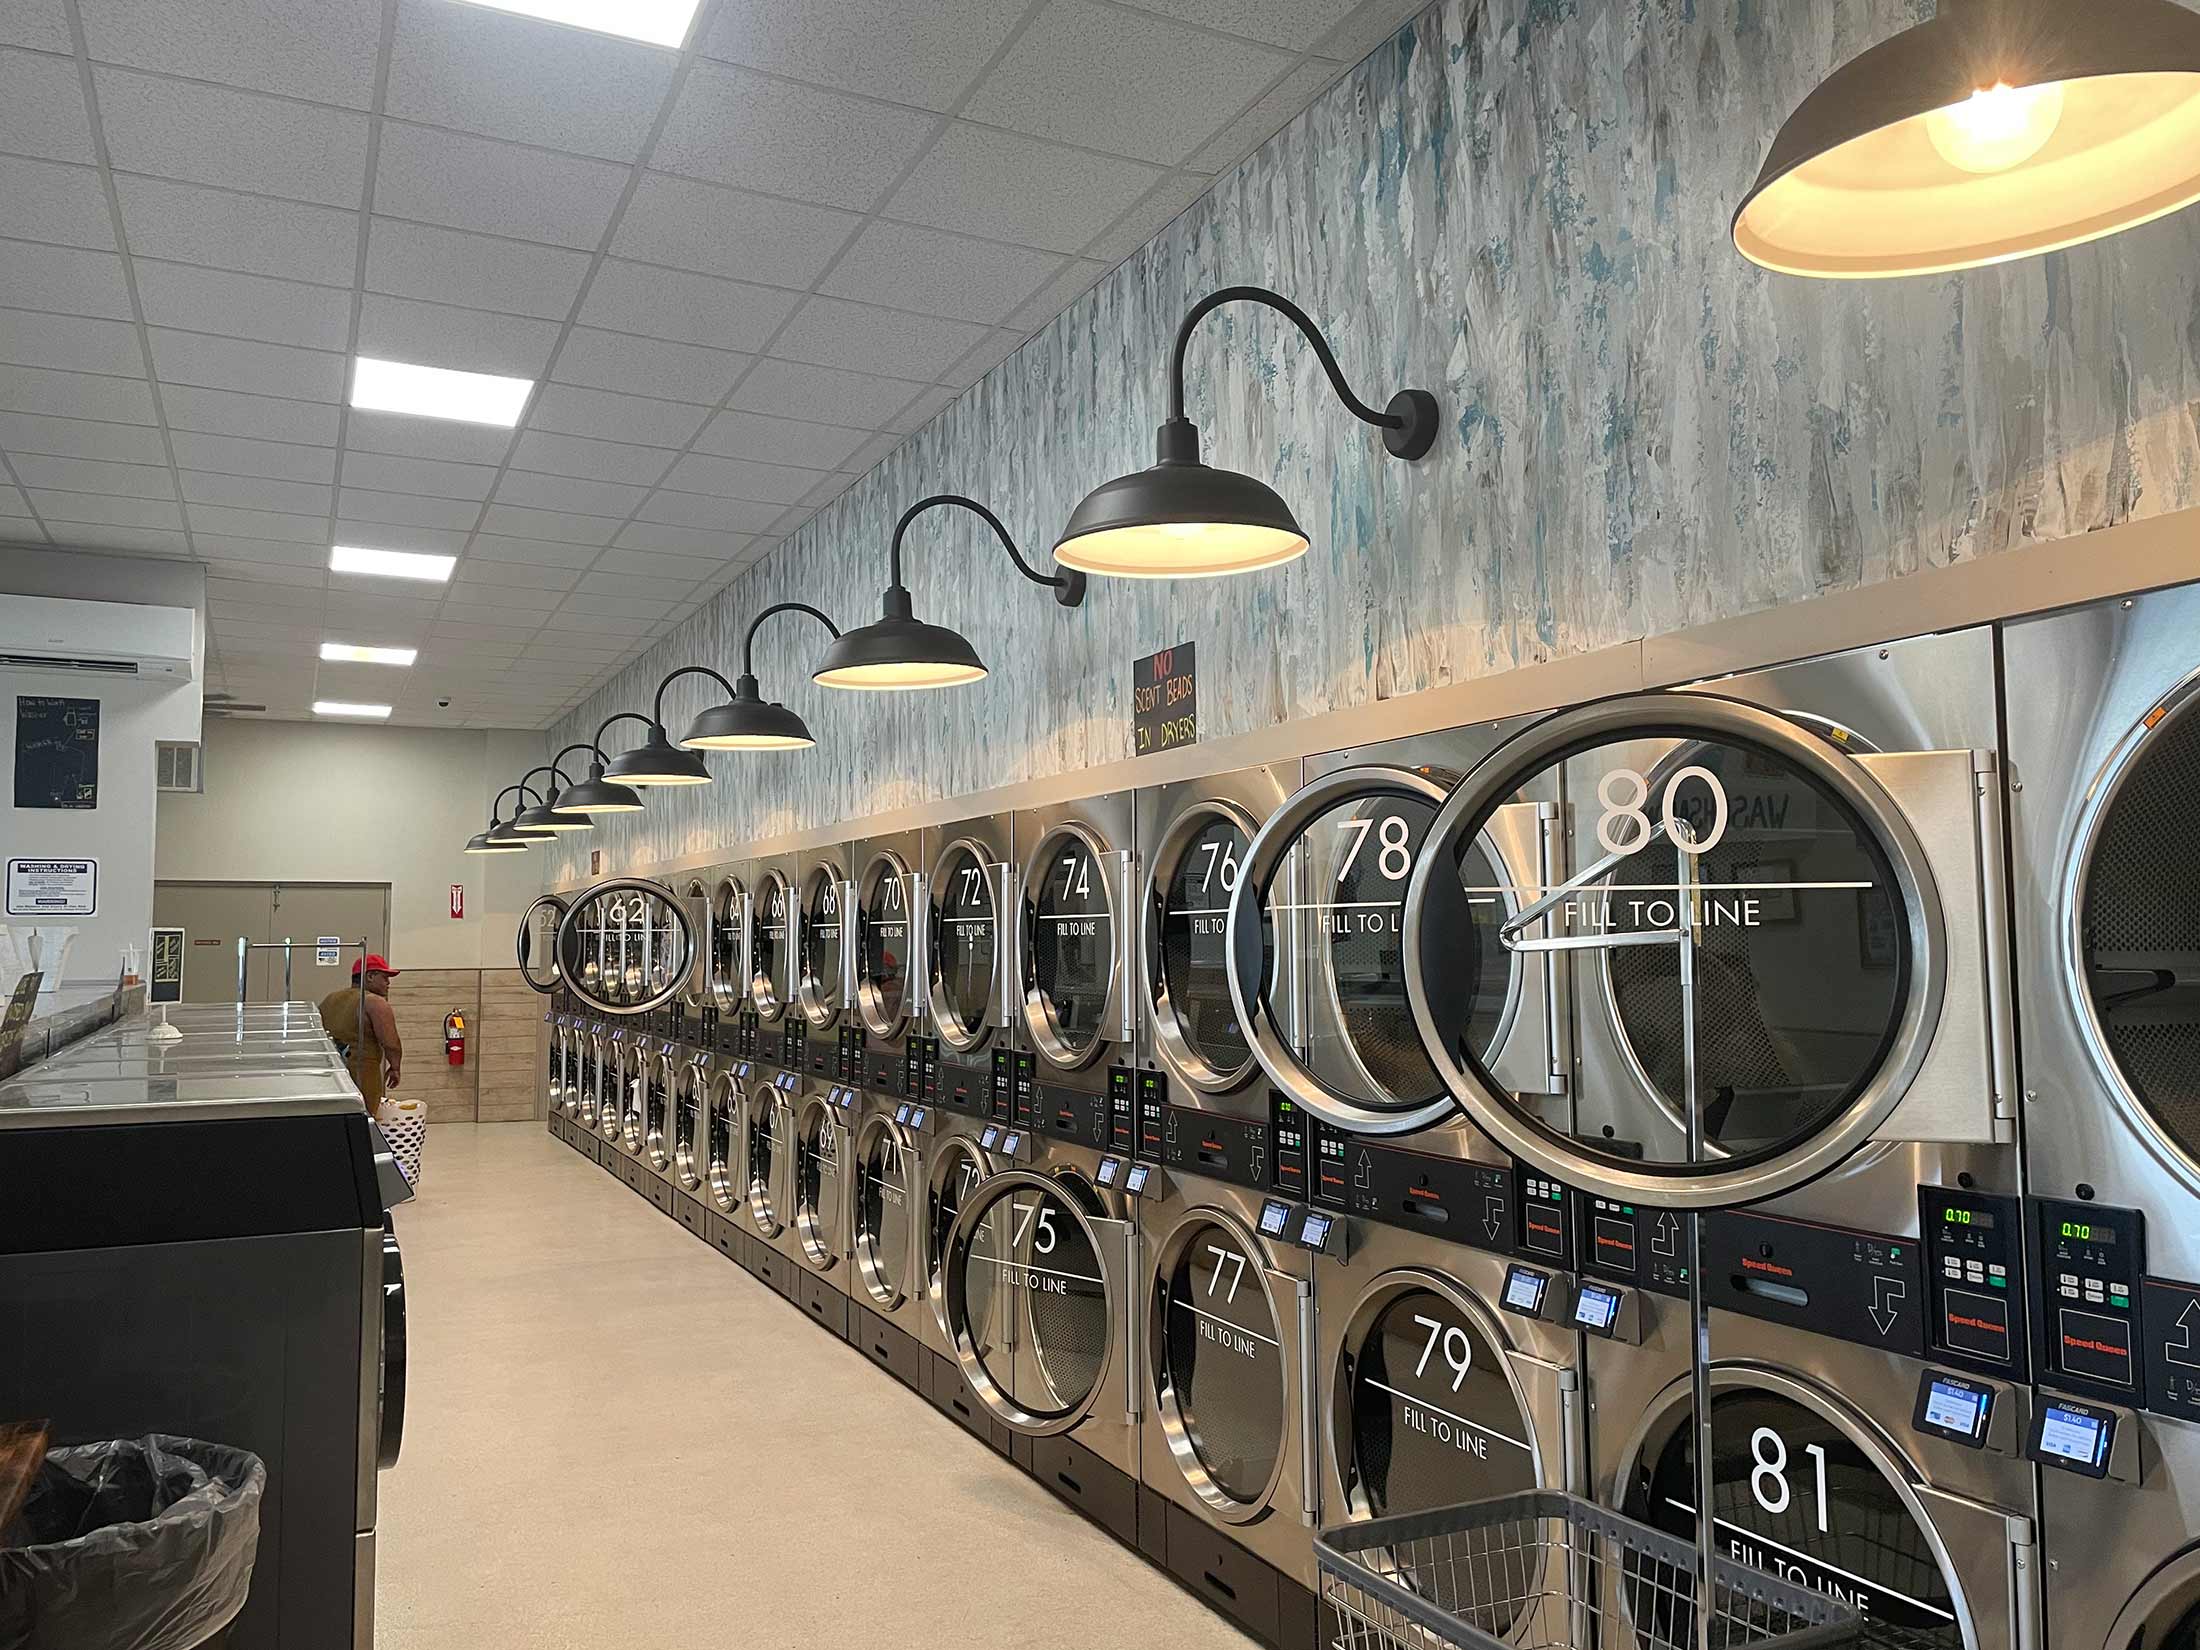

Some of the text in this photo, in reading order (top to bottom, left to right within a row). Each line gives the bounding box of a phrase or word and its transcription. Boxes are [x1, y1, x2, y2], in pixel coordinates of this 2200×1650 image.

[1153, 650, 1173, 680] NO
[1135, 674, 1193, 713] SCENT BEADS
[1137, 713, 1196, 749] IN DRYERS
[1597, 766, 1728, 855] 80
[1337, 815, 1411, 883] 78
[1062, 855, 1090, 901] 74
[1201, 840, 1239, 893] 76
[823, 884, 836, 915] 68
[884, 877, 901, 911] 70
[961, 867, 981, 906] 72
[610, 897, 645, 922] 62
[771, 891, 783, 918] 66
[1565, 900, 1760, 927] FILL TO LINE
[1057, 922, 1096, 935] FILL TO LINE
[1194, 918, 1225, 934] FILL TO
[1322, 914, 1351, 934] FILL
[1357, 913, 1384, 933] TO
[820, 1119, 833, 1150] 69
[883, 1138, 896, 1175] 71
[1012, 1203, 1056, 1254] 75
[1945, 1208, 1971, 1224] 0.70
[2062, 1222, 2090, 1240] 0.70
[1002, 1269, 1067, 1295] FILL TO LINE
[1207, 1244, 1247, 1304] 77
[1742, 1257, 1793, 1277] Speed Queen
[1948, 1313, 2005, 1333] Speed Queen
[1200, 1320, 1257, 1359] FILL TO LINE
[1414, 1314, 1472, 1393] 79
[2063, 1335, 2127, 1356] Speed Queen
[1943, 1377, 1970, 1390] FASCARD
[2058, 1402, 2089, 1416] FASCARD
[2063, 1413, 2082, 1424] $1.40
[1404, 1406, 1488, 1460] FILL TO LINE
[1751, 1426, 1828, 1533] 81
